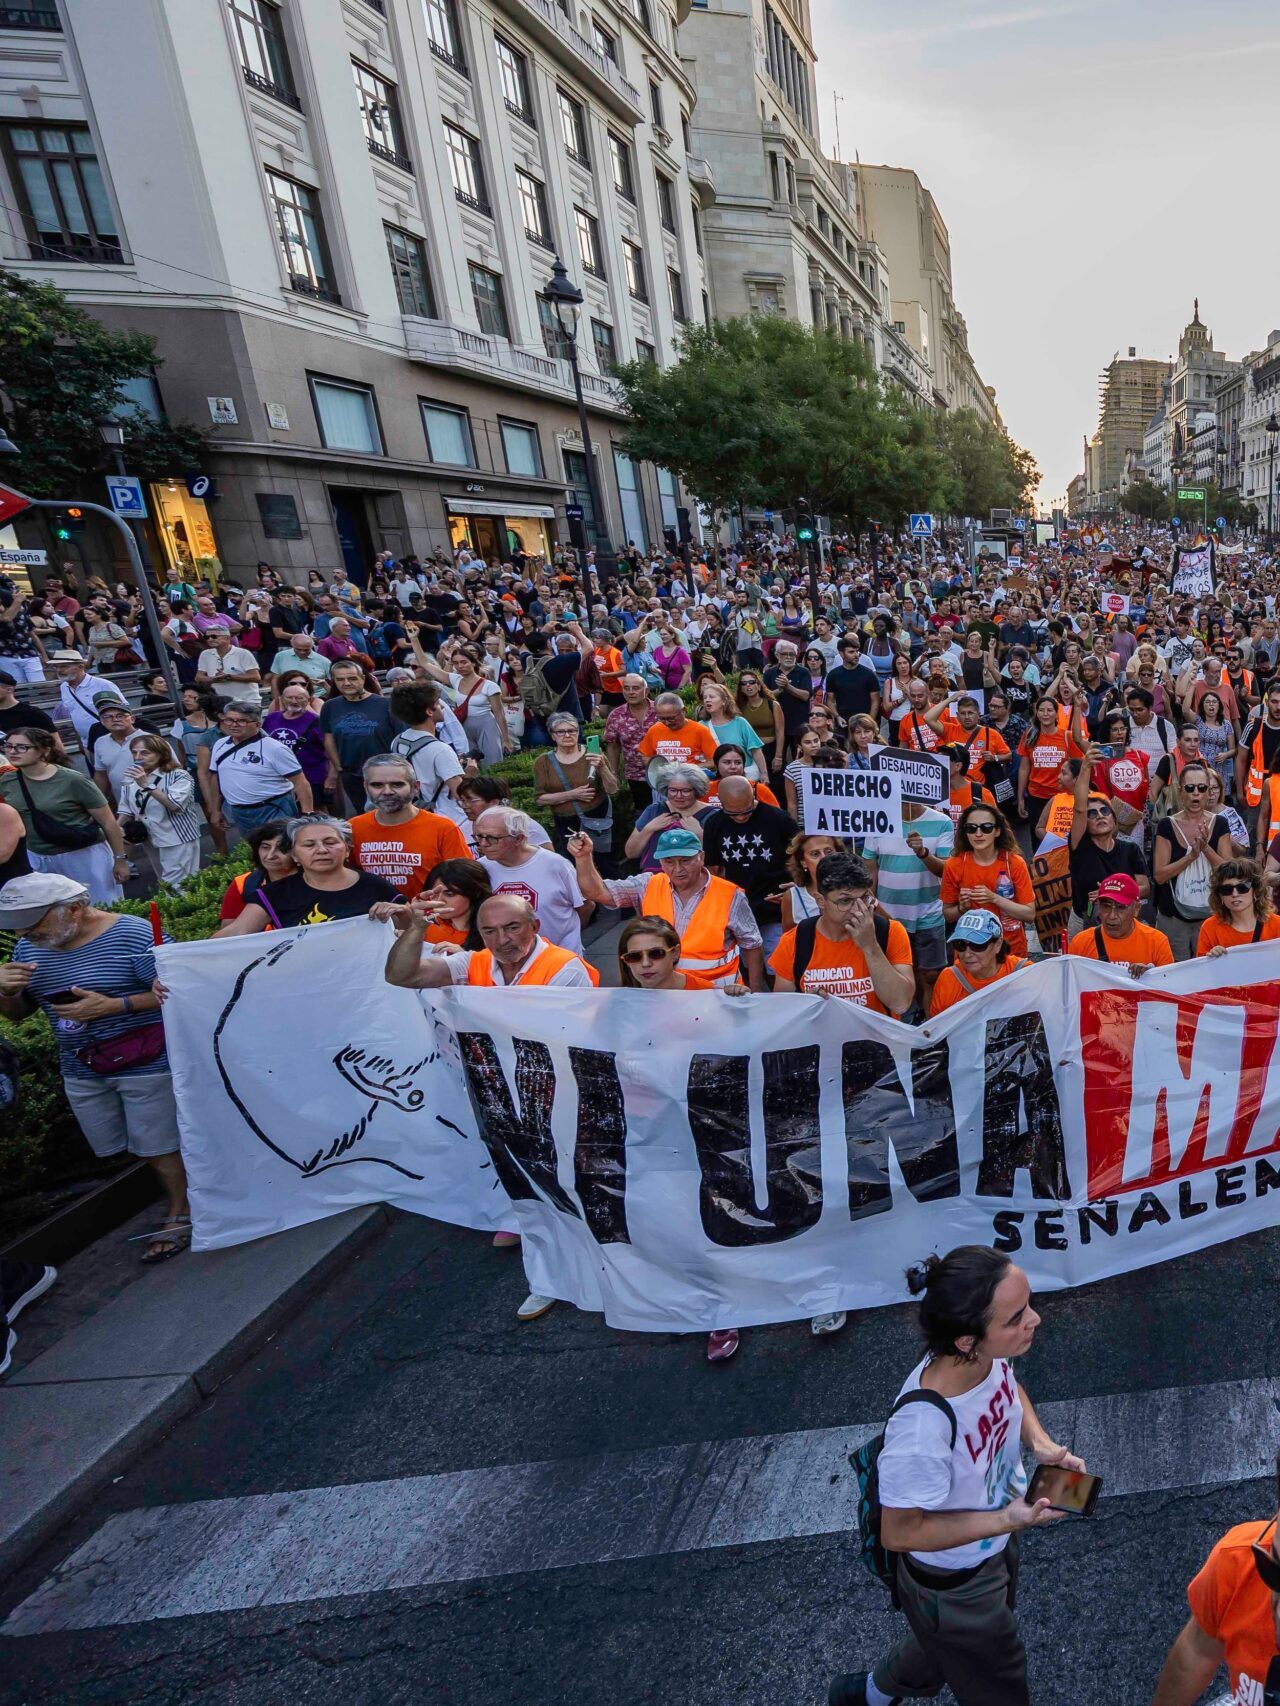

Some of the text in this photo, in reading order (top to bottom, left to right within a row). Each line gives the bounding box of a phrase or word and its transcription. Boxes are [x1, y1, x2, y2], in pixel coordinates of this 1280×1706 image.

[114, 488, 132, 507] P
[0, 552, 40, 563] España
[881, 757, 941, 779] DESAHUCIOS
[1114, 768, 1139, 777] STOP
[811, 772, 892, 799] DERECHO
[901, 780, 941, 798] AMES!!!
[818, 808, 894, 834] A TECHO.
[360, 842, 404, 852] SINDICATO
[360, 854, 420, 865] DE INQUILINAS
[384, 876, 408, 885] DRID
[804, 967, 854, 981] SINDICATO
[456, 1031, 631, 1244] NI
[686, 1010, 1072, 1248] UNA
